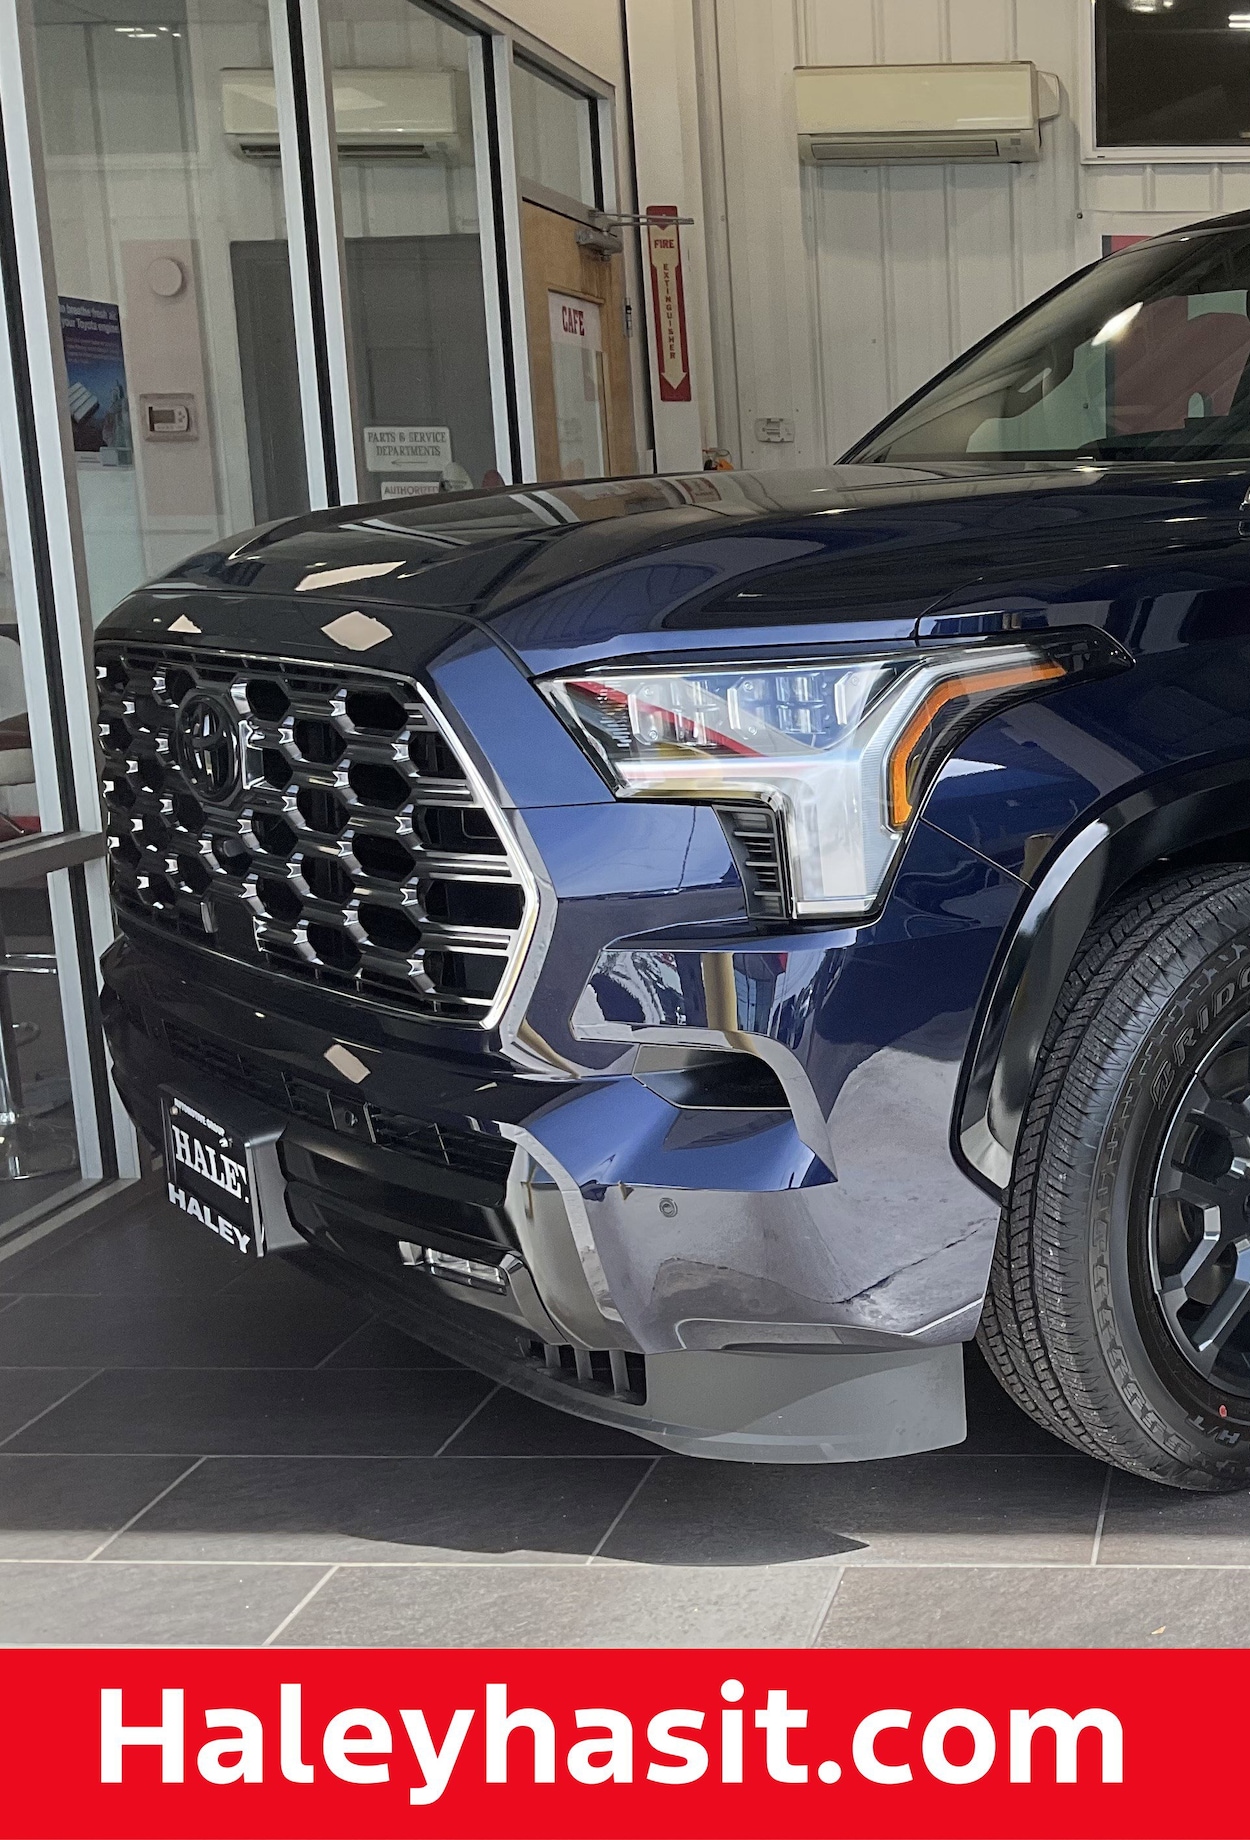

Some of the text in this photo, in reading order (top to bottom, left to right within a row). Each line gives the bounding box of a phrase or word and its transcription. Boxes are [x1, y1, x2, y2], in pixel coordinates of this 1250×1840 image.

[654, 239, 674, 249] FIRE
[562, 305, 585, 336] CAFE
[663, 263, 676, 359] EXTINGUISHER
[367, 432, 396, 443] PARTS
[408, 432, 447, 443] SERVICE
[376, 445, 441, 456] DEPARTMENTS
[168, 1182, 251, 1254] HALEY
